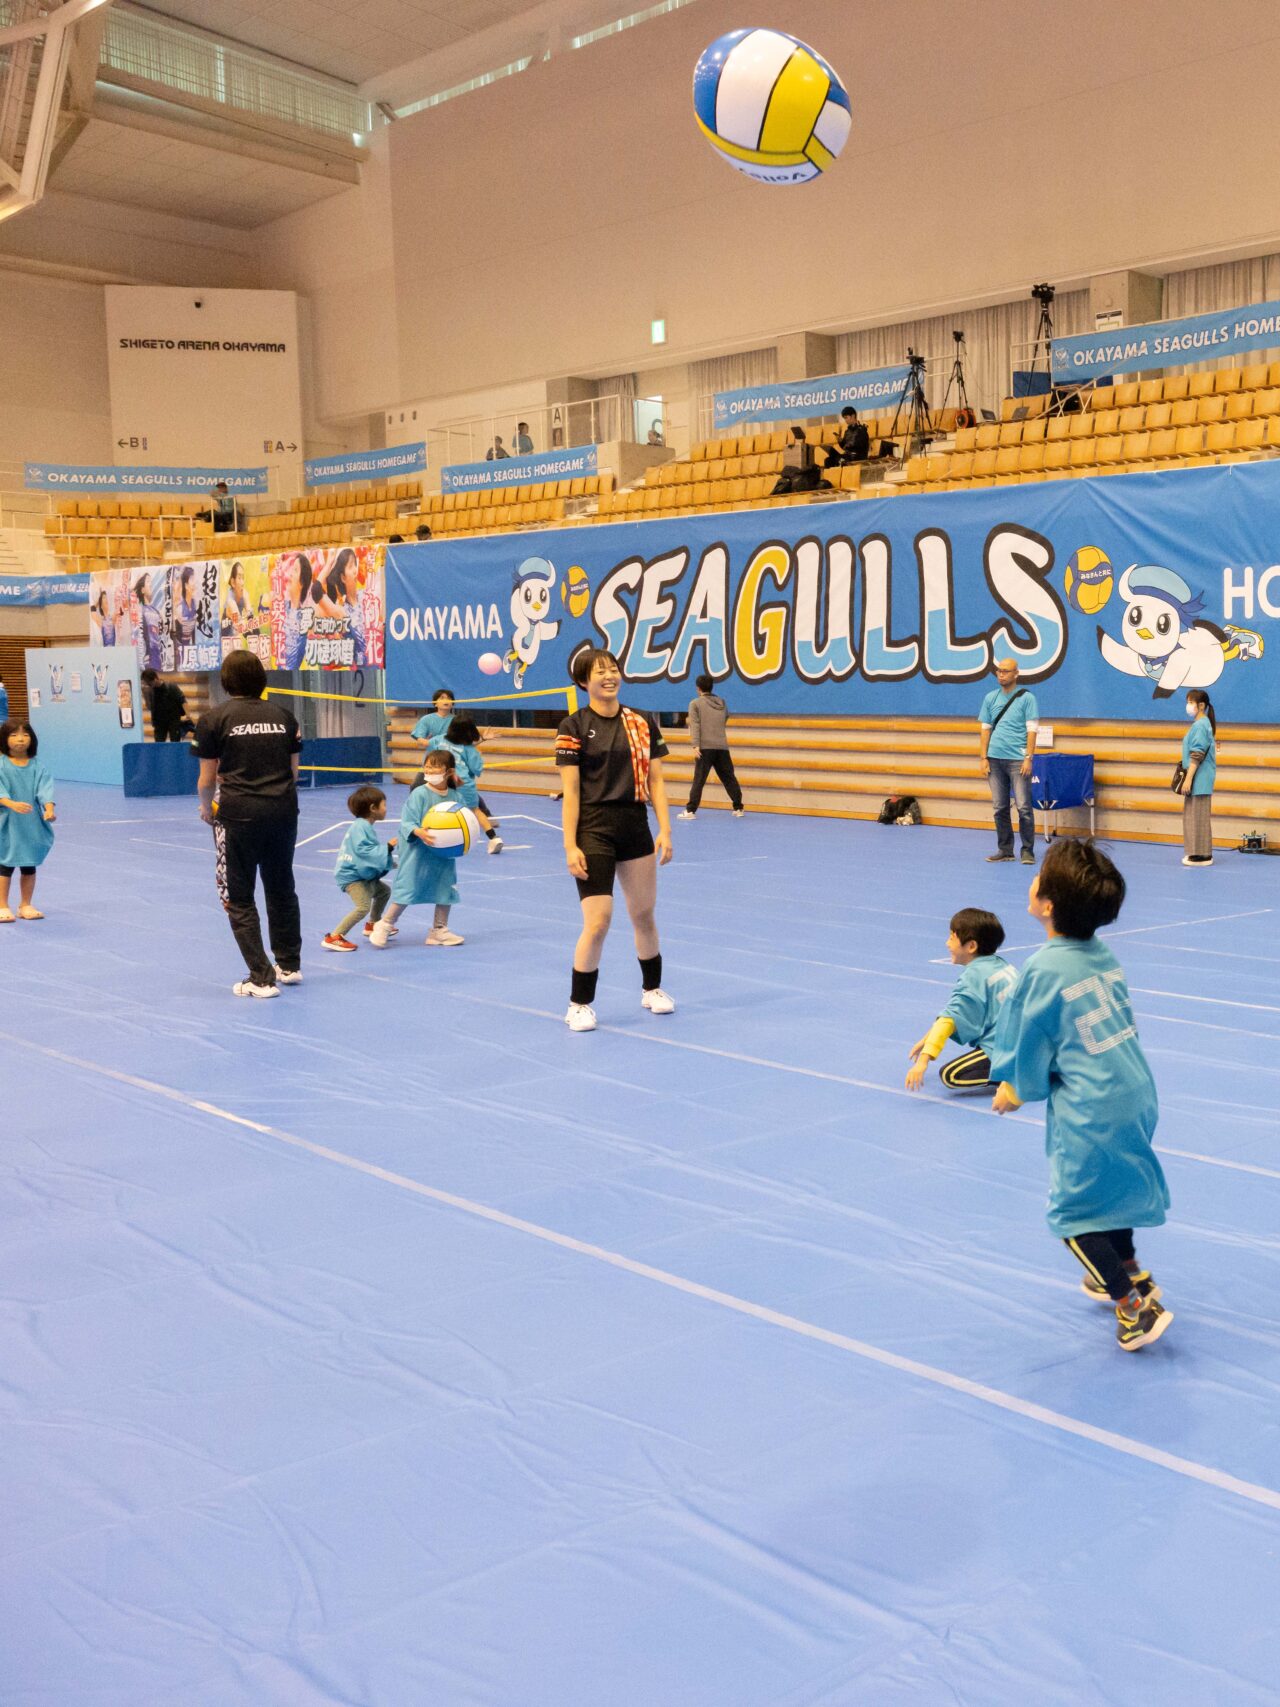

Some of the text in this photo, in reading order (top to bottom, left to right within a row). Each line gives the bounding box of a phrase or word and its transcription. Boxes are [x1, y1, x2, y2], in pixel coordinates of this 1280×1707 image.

[119, 338, 286, 353] SHIGETO ARENA OKAYAMA
[1073, 341, 1149, 366] OKAYAMA
[1153, 326, 1229, 355] SEAGULLS
[729, 378, 908, 415] OKAYAMA SEAGULLS HOMEGAME
[553, 406, 561, 423] A
[129, 437, 139, 448] B
[275, 441, 285, 451] A
[314, 453, 417, 478] OKAYAMA SEAGULLS HOMEGAME
[452, 460, 584, 487] OKAYAMA SEAGULLS HOMEGAME
[47, 472, 256, 487] OKAYAMA SEAGULLS HOMEGAME
[389, 604, 503, 641] OKAYAMA
[568, 522, 1068, 685] SEAGULLS
[229, 723, 287, 737] SEAGULLS
